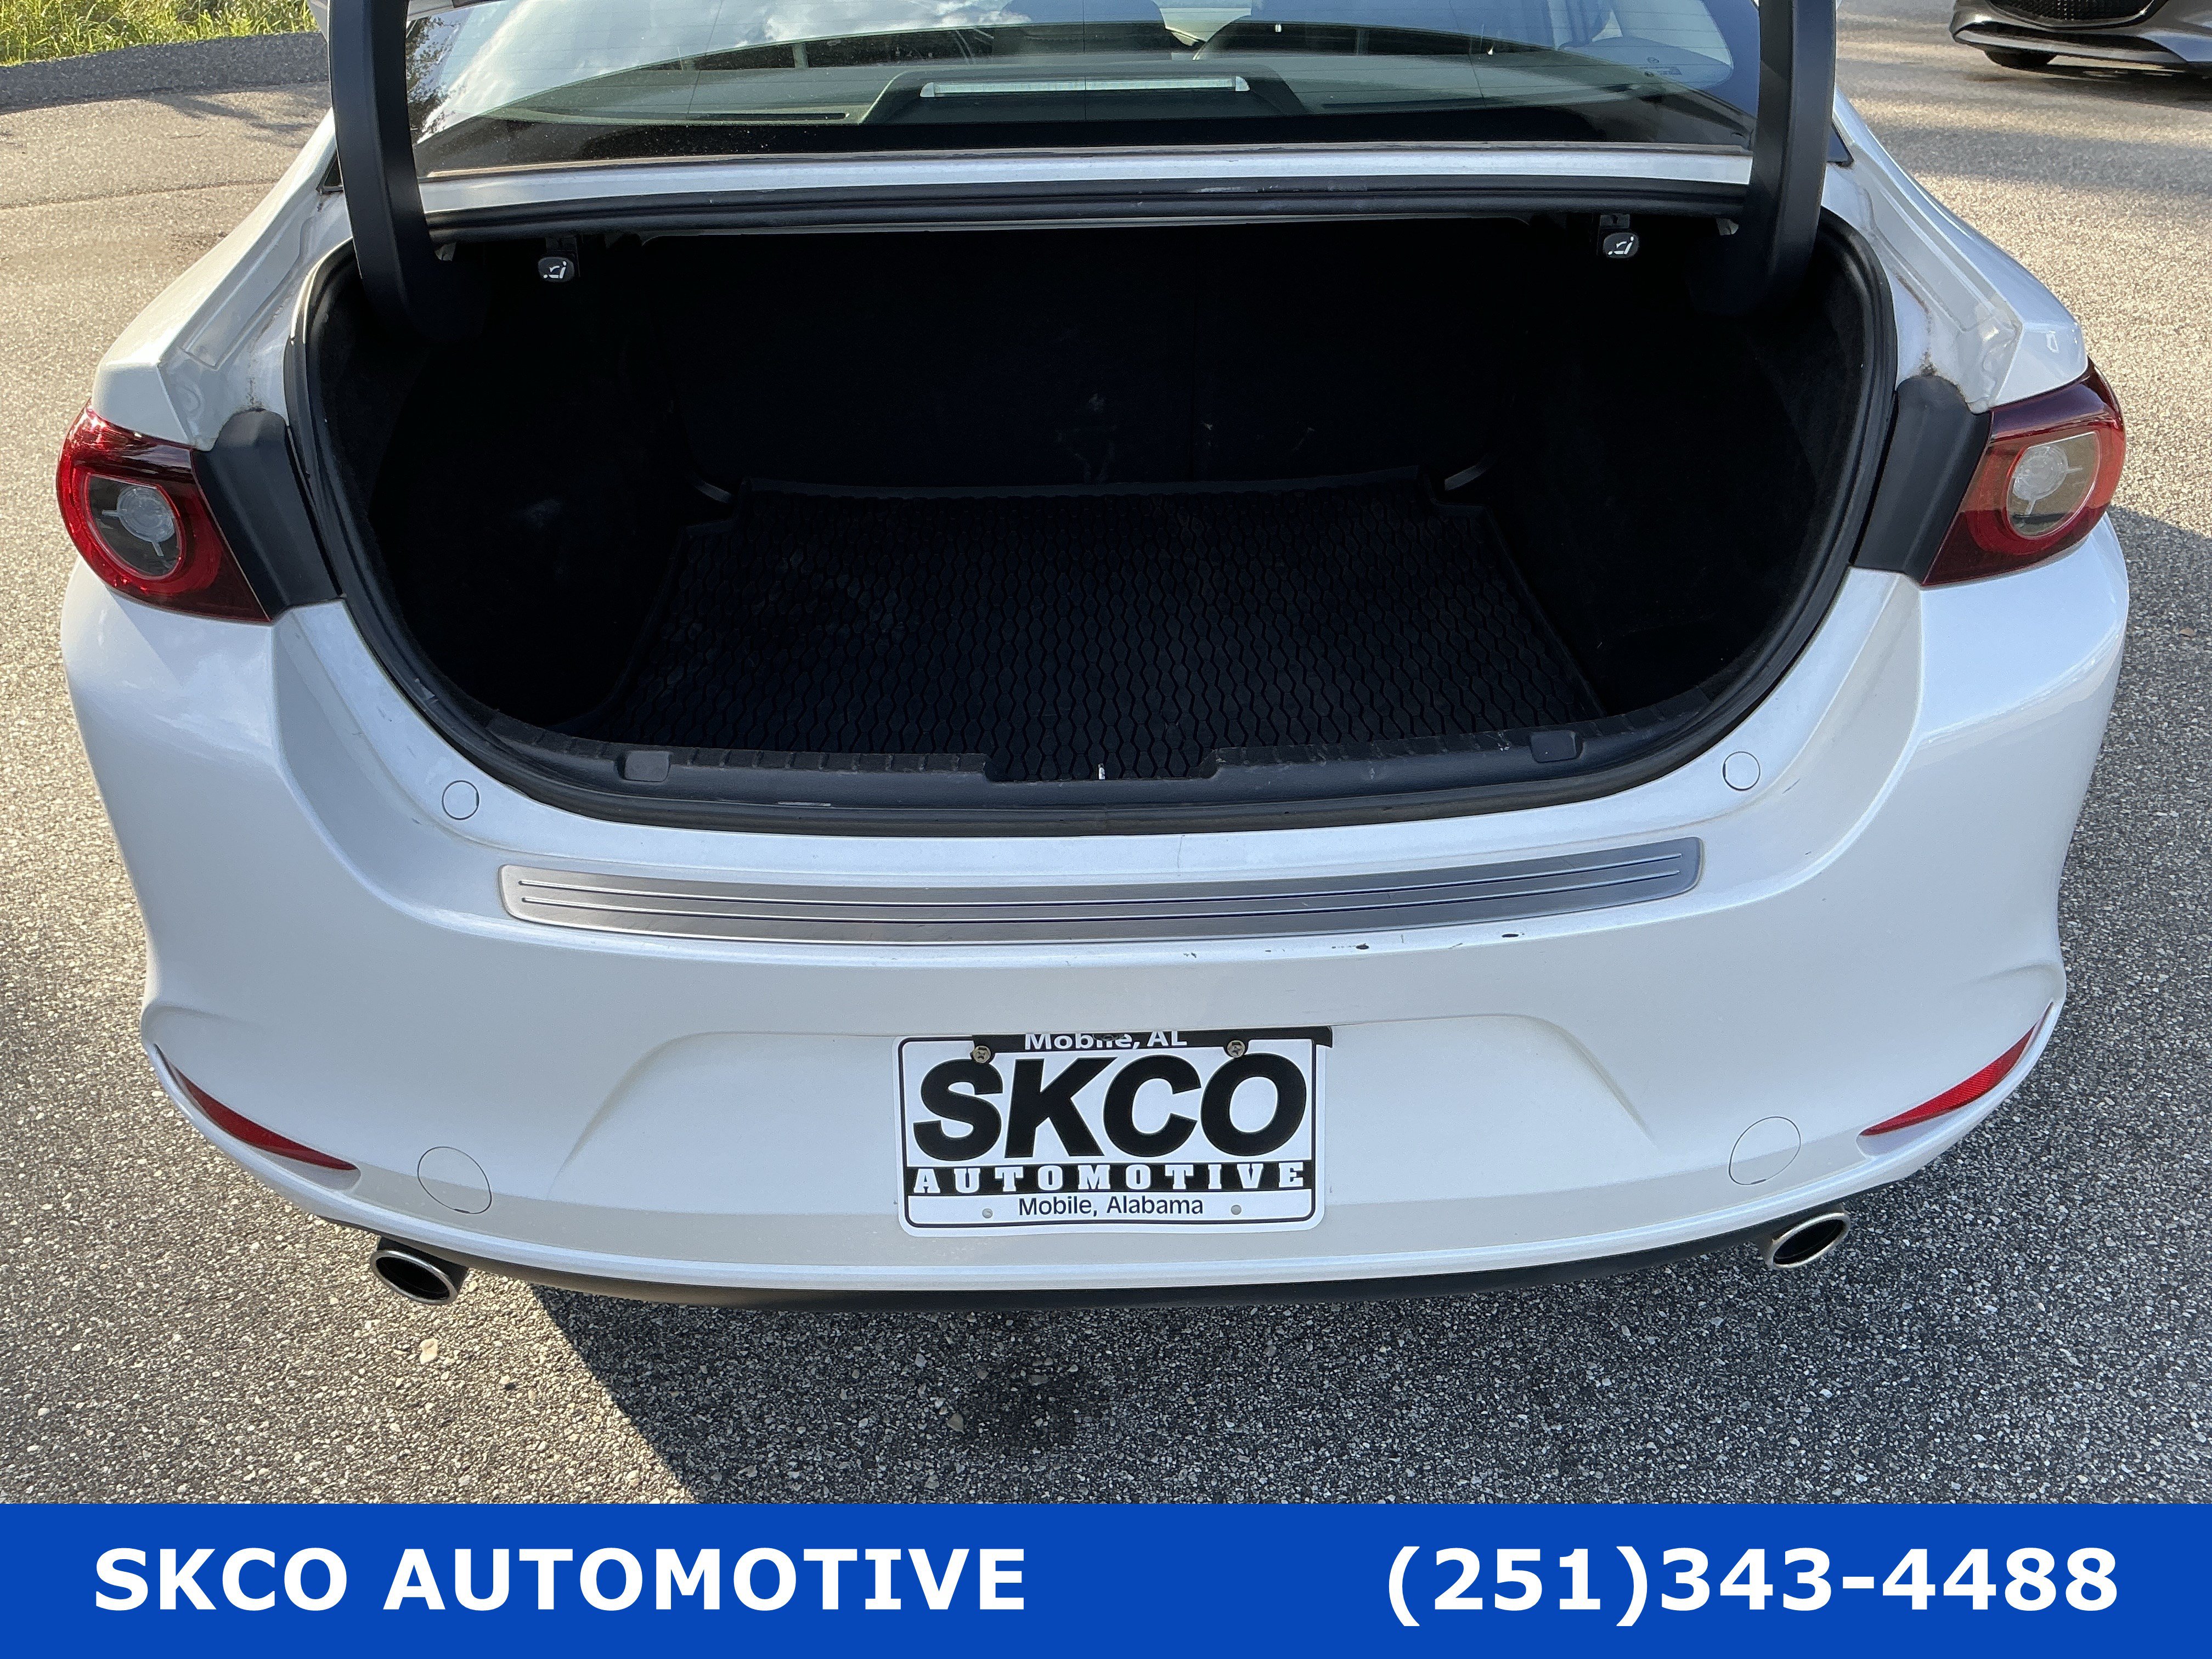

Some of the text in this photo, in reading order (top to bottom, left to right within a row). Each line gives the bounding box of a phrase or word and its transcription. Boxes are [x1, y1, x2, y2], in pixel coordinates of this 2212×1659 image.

[1146, 1030, 1187, 1047] AL
[913, 1053, 1307, 1161] SKCO
[913, 1162, 1304, 1194] AUTOMOTIVE
[1019, 1195, 1204, 1217] Mobile, Alabama
